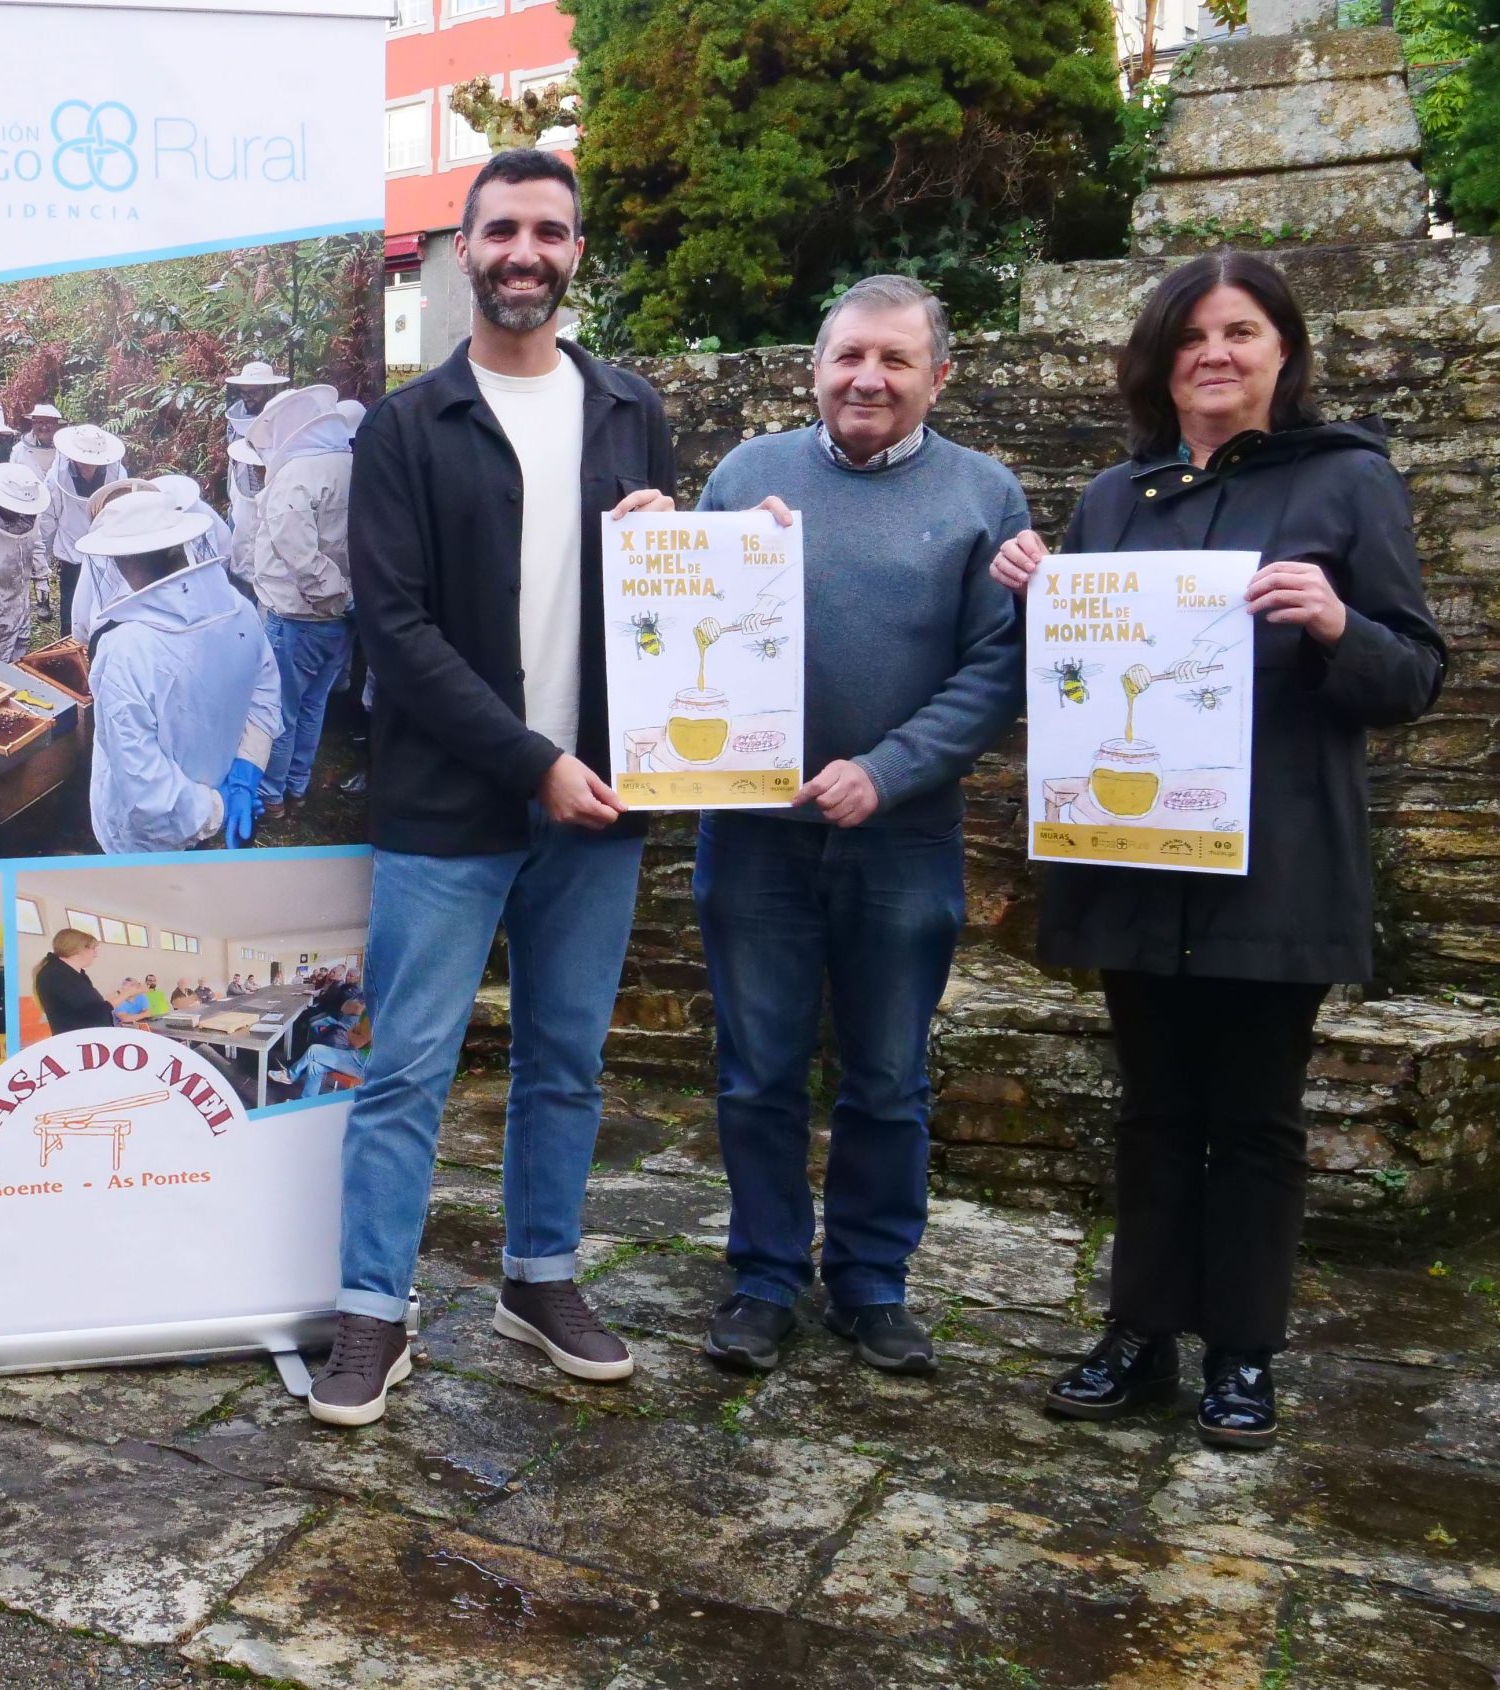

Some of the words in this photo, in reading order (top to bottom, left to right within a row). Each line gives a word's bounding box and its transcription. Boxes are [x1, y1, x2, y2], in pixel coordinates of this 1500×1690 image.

[153, 116, 308, 183] Rural
[620, 530, 635, 551] X
[645, 529, 709, 551] FEIRA
[740, 533, 761, 552] 16
[629, 554, 644, 566] DO
[646, 553, 686, 575] MEL
[687, 563, 701, 574] DE
[743, 552, 786, 566] MURAS
[621, 575, 716, 597] MONTAÑA
[1045, 573, 1061, 595] X
[1070, 571, 1140, 595] FEIRA
[1175, 574, 1197, 594] 16
[1052, 598, 1068, 610] DO
[1070, 597, 1114, 619] MEL
[1115, 607, 1131, 619] DE
[1176, 595, 1228, 608] MURAS
[1044, 619, 1147, 642] MONTAÑA
[1040, 831, 1070, 841] MURAS
[76, 1041, 149, 1072] DO
[156, 1054, 235, 1138] MEL
[107, 1174, 135, 1190] As
[141, 1170, 212, 1187] Pontes
